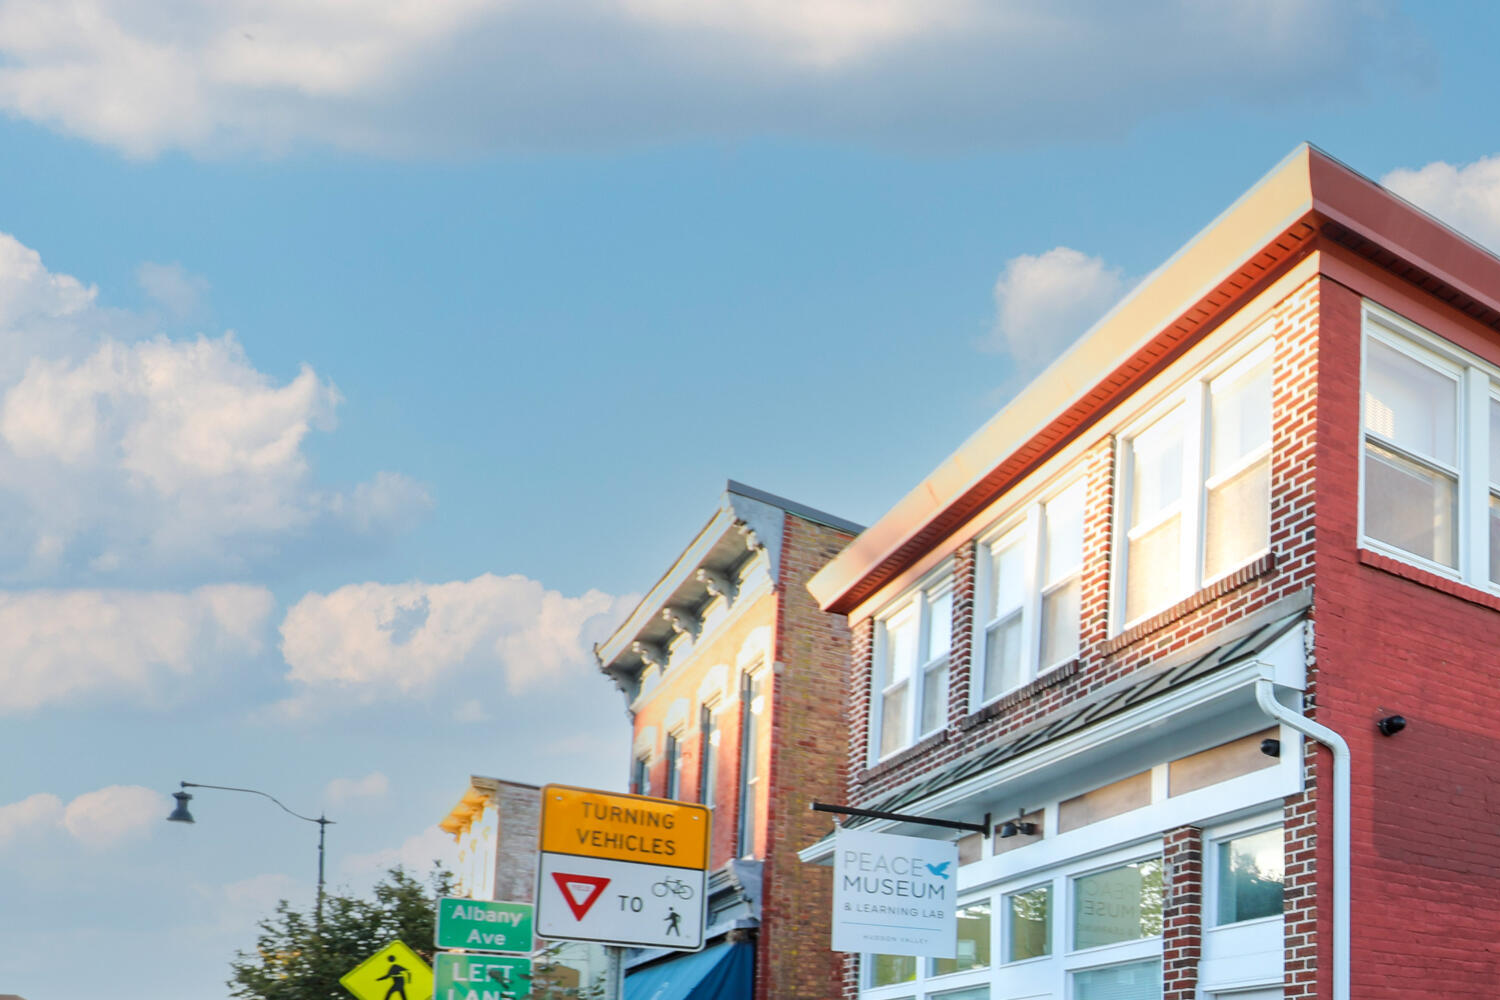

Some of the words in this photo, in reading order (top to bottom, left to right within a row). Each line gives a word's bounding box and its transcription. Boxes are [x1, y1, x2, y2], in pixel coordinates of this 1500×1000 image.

[582, 802, 675, 830] TURNING
[576, 828, 676, 856] VEHICLES
[844, 850, 923, 878] PEACE
[843, 875, 945, 901] MUSEUM
[618, 894, 643, 913] TO
[844, 902, 852, 911] &
[856, 903, 919, 917] LEARNING
[922, 909, 944, 919] LAB
[452, 904, 523, 927] Albany
[466, 929, 506, 945] Ave
[453, 962, 514, 982] LEFT
